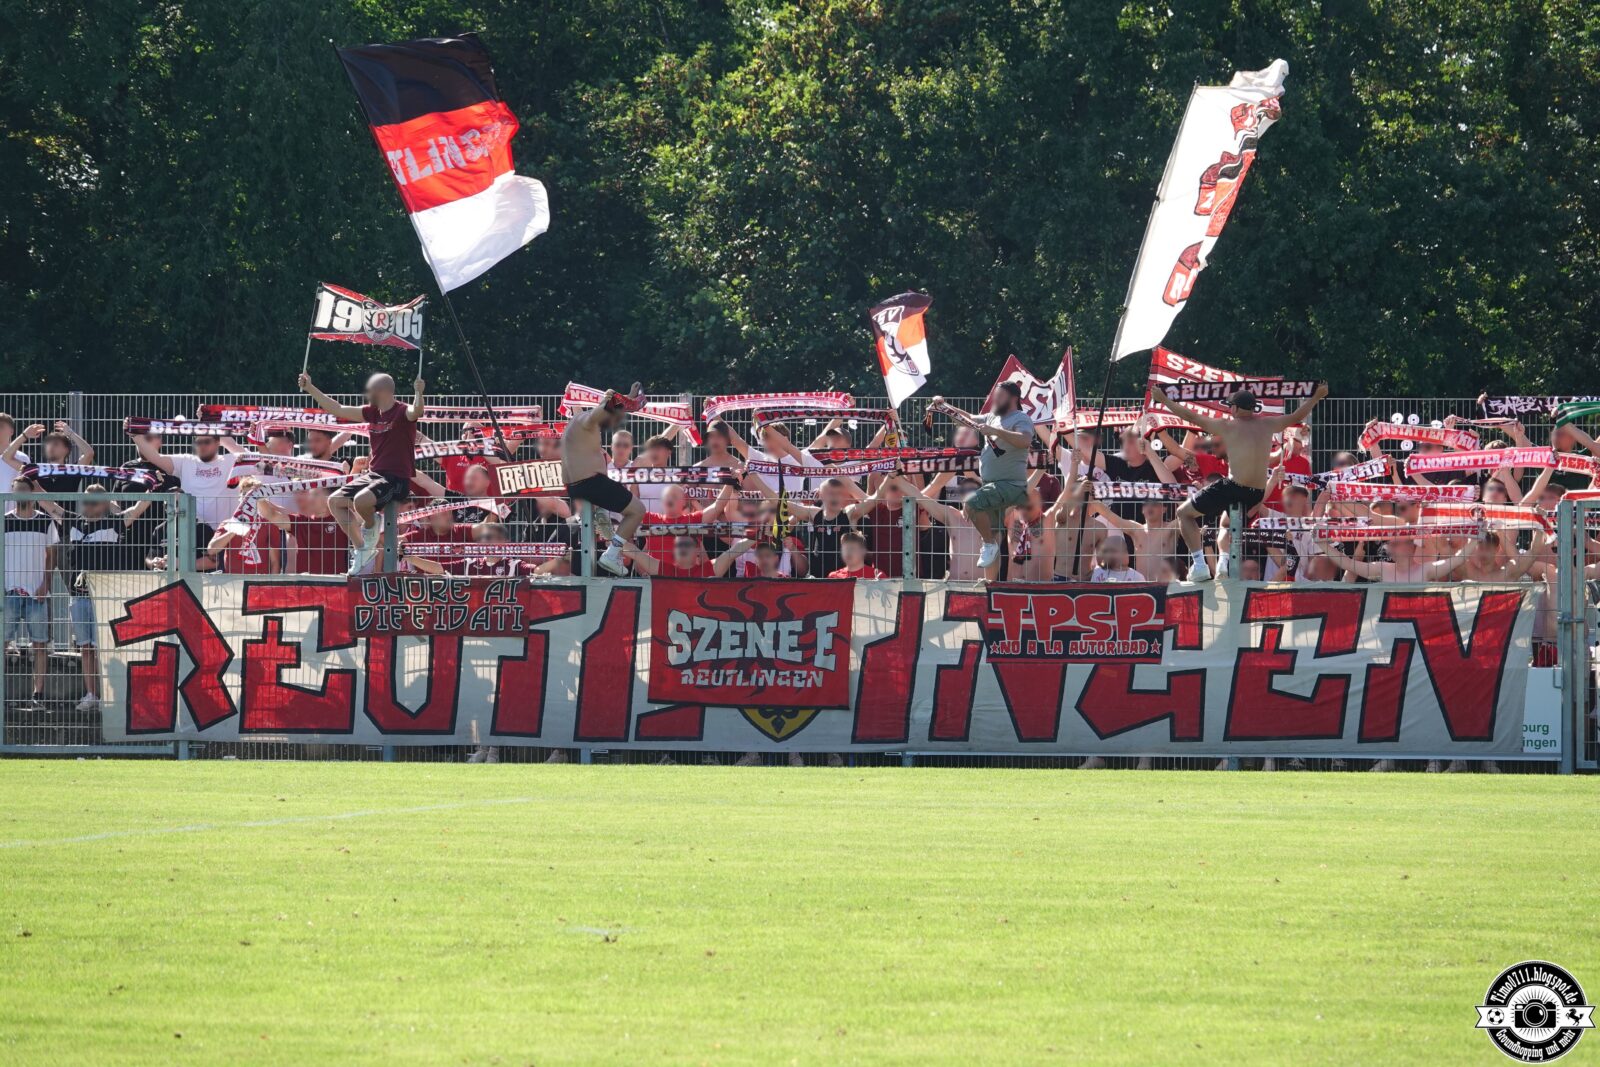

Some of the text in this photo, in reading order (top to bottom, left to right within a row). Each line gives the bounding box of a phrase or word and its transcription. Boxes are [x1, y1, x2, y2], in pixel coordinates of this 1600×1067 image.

[221, 410, 337, 425] KREUZEICHE
[149, 420, 226, 436] BLOCK
[872, 461, 895, 472] 2005
[1409, 454, 1500, 470] CANNSTATTER
[38, 464, 109, 478] BLOCK
[607, 467, 682, 483] BLOCK
[1094, 483, 1164, 498] BLOCK
[464, 545, 533, 555] REUTLINGEN
[362, 577, 522, 604] ONORE AI
[355, 604, 524, 631] DIFFIDATI
[991, 592, 1157, 643] TPSP
[667, 608, 839, 672] SZENE E
[1000, 640, 1149, 656] NO A LA AUTORIDAD
[680, 668, 824, 689] REUTLINGEN
